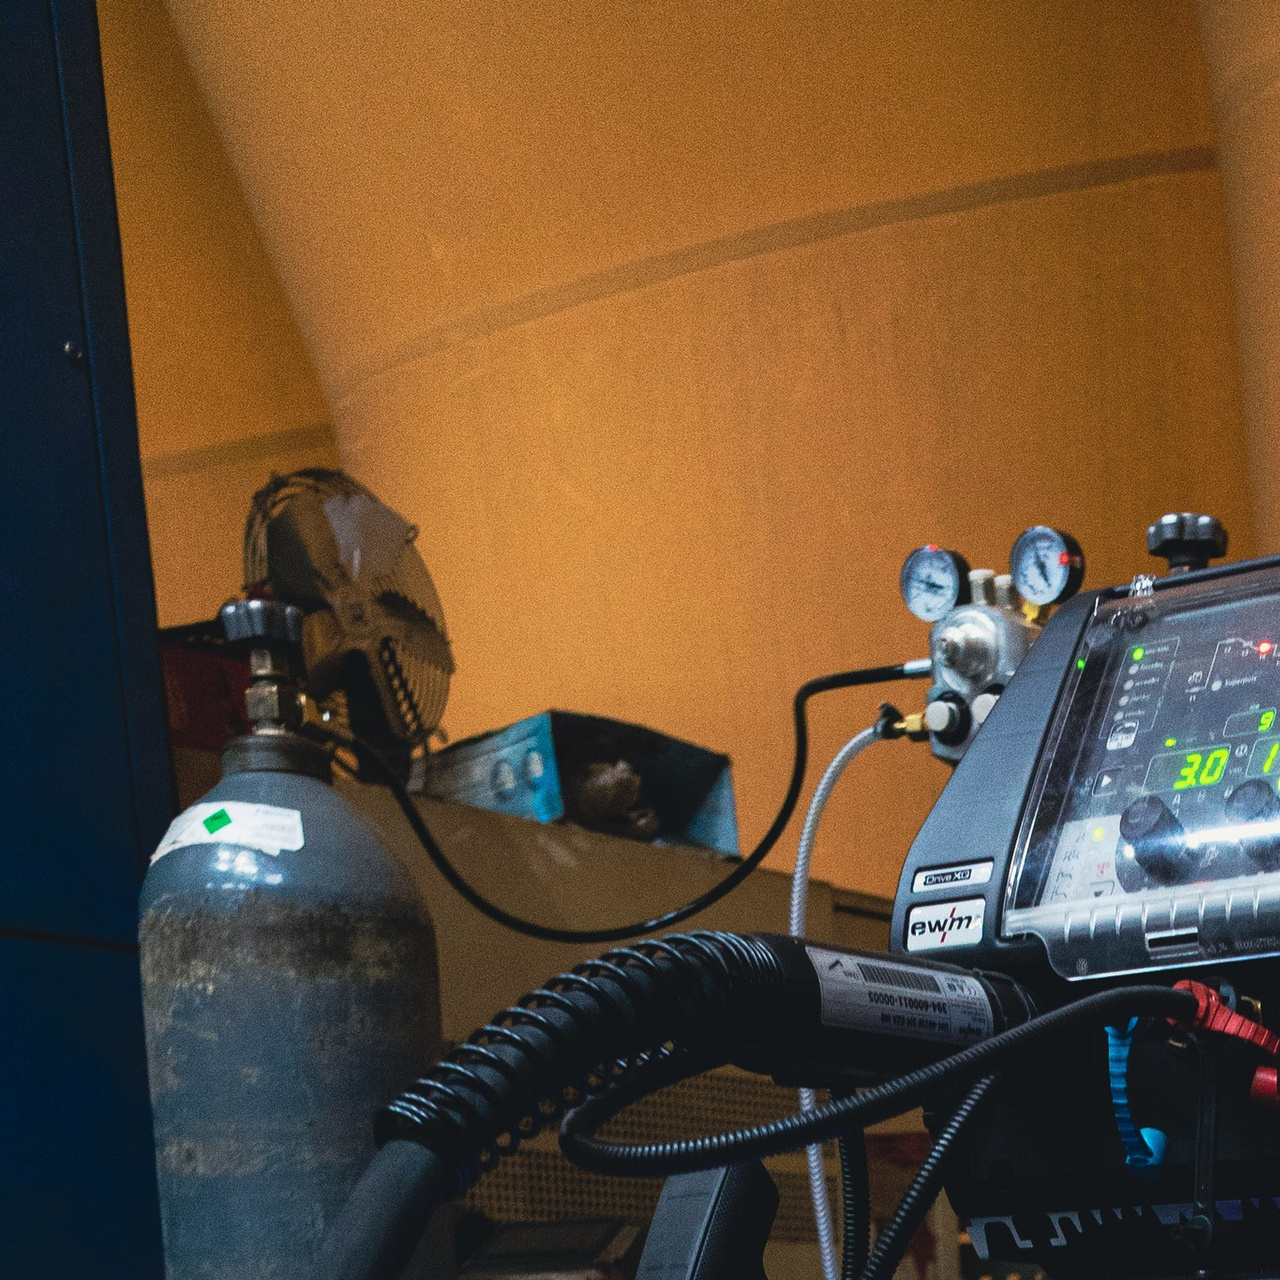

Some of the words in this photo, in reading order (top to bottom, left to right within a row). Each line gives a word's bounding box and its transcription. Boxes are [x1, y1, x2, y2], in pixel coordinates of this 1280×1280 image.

[1258, 711, 1274, 731] 9
[1173, 748, 1229, 790] 3.0
[926, 874, 952, 884] Drive
[911, 907, 972, 943] ewm
